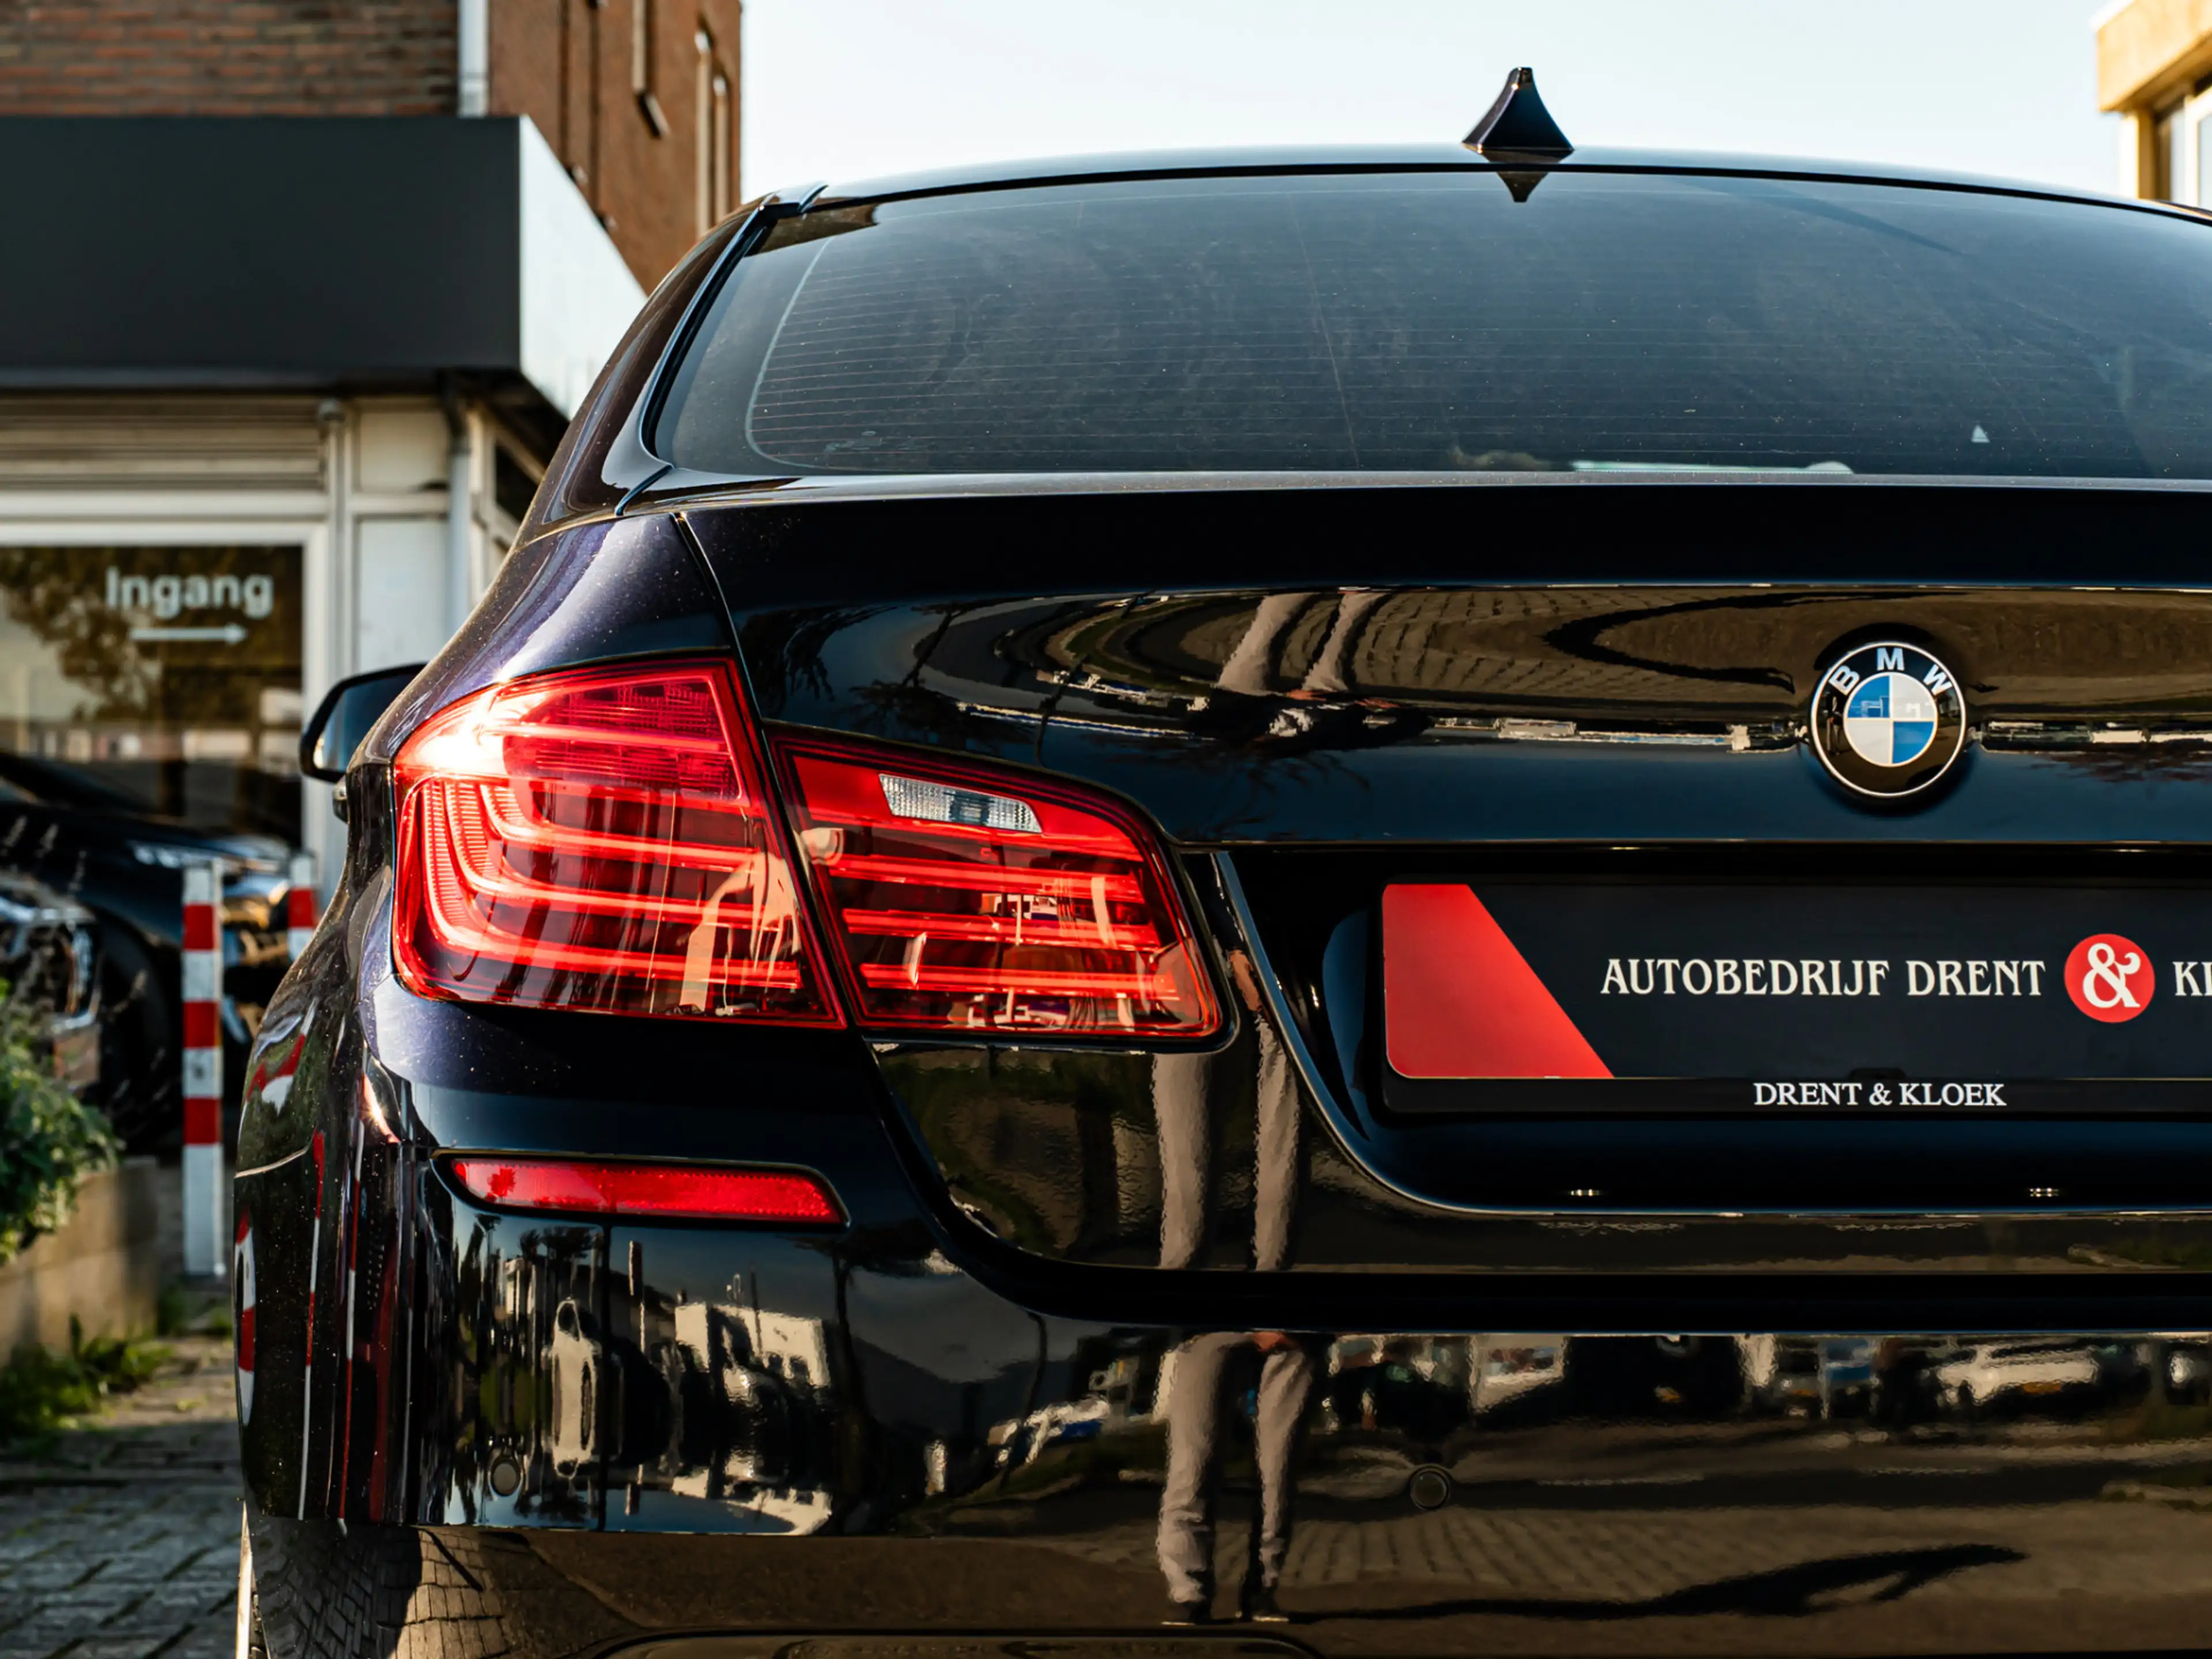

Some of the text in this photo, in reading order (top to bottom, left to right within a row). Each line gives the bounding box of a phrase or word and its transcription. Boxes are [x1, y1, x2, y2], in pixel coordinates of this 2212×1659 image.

[105, 566, 274, 620] Ingang
[1828, 647, 1953, 696] BMW
[1600, 959, 1890, 996] AUTOBEDRIJF
[1906, 960, 2046, 996] DRENT
[2082, 942, 2141, 1008] &
[1752, 1082, 2008, 1106] DRENT & KLOEK
